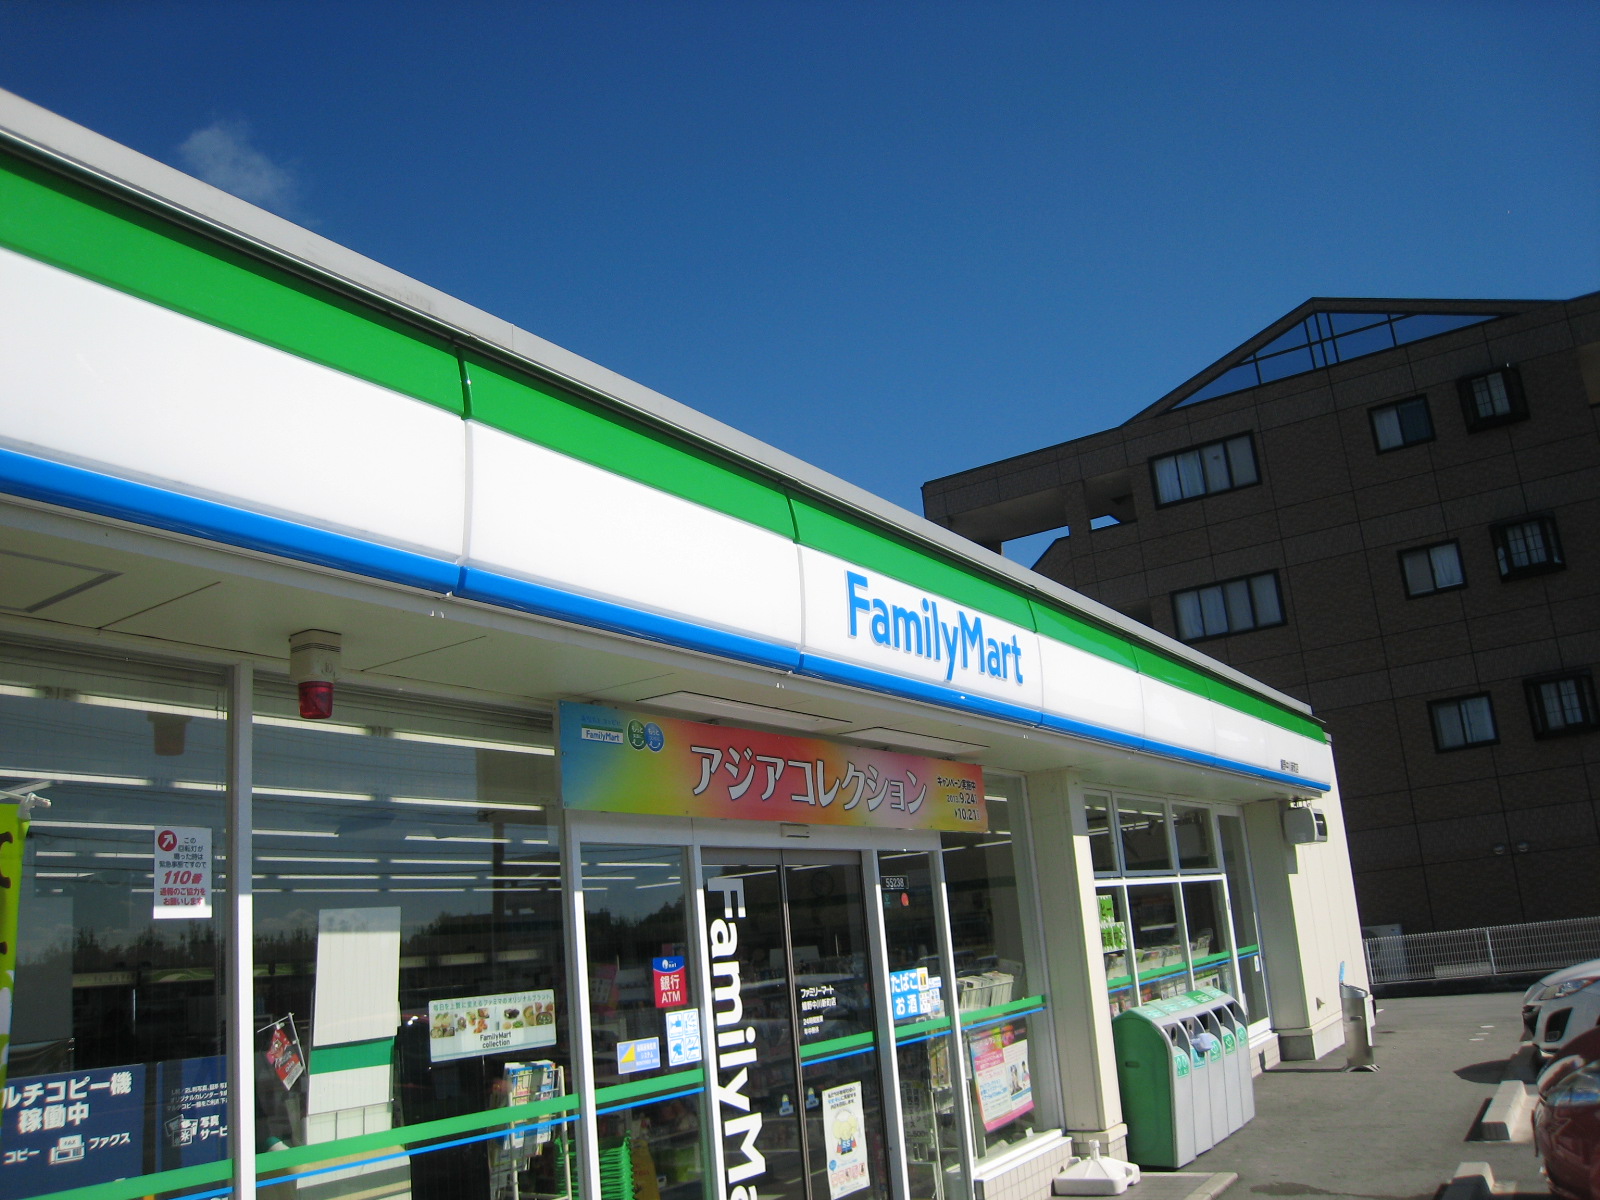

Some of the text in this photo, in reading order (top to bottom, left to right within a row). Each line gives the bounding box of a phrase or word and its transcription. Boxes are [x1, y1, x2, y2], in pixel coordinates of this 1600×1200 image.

[845, 570, 1023, 686] FamilyMart
[586, 729, 620, 742] FamilyMart
[690, 745, 927, 814] アジアコレクション
[178, 845, 204, 853] 回転灯が
[164, 870, 203, 885] 110番
[885, 877, 905, 888] 55238
[160, 887, 206, 896] 通報のご協力を
[660, 974, 680, 991] 銀行
[890, 972, 918, 995] たばこ
[661, 991, 681, 1004] ATM
[801, 985, 834, 998] ファミリーマート
[895, 994, 918, 1015] お酒
[480, 1031, 511, 1041] FamilyMart
[482, 1039, 511, 1048] collection
[17, 1101, 90, 1134] 稼働中
[200, 1115, 220, 1127] 写真
[88, 1132, 131, 1150] ファクス
[3, 1147, 41, 1164] コピー
